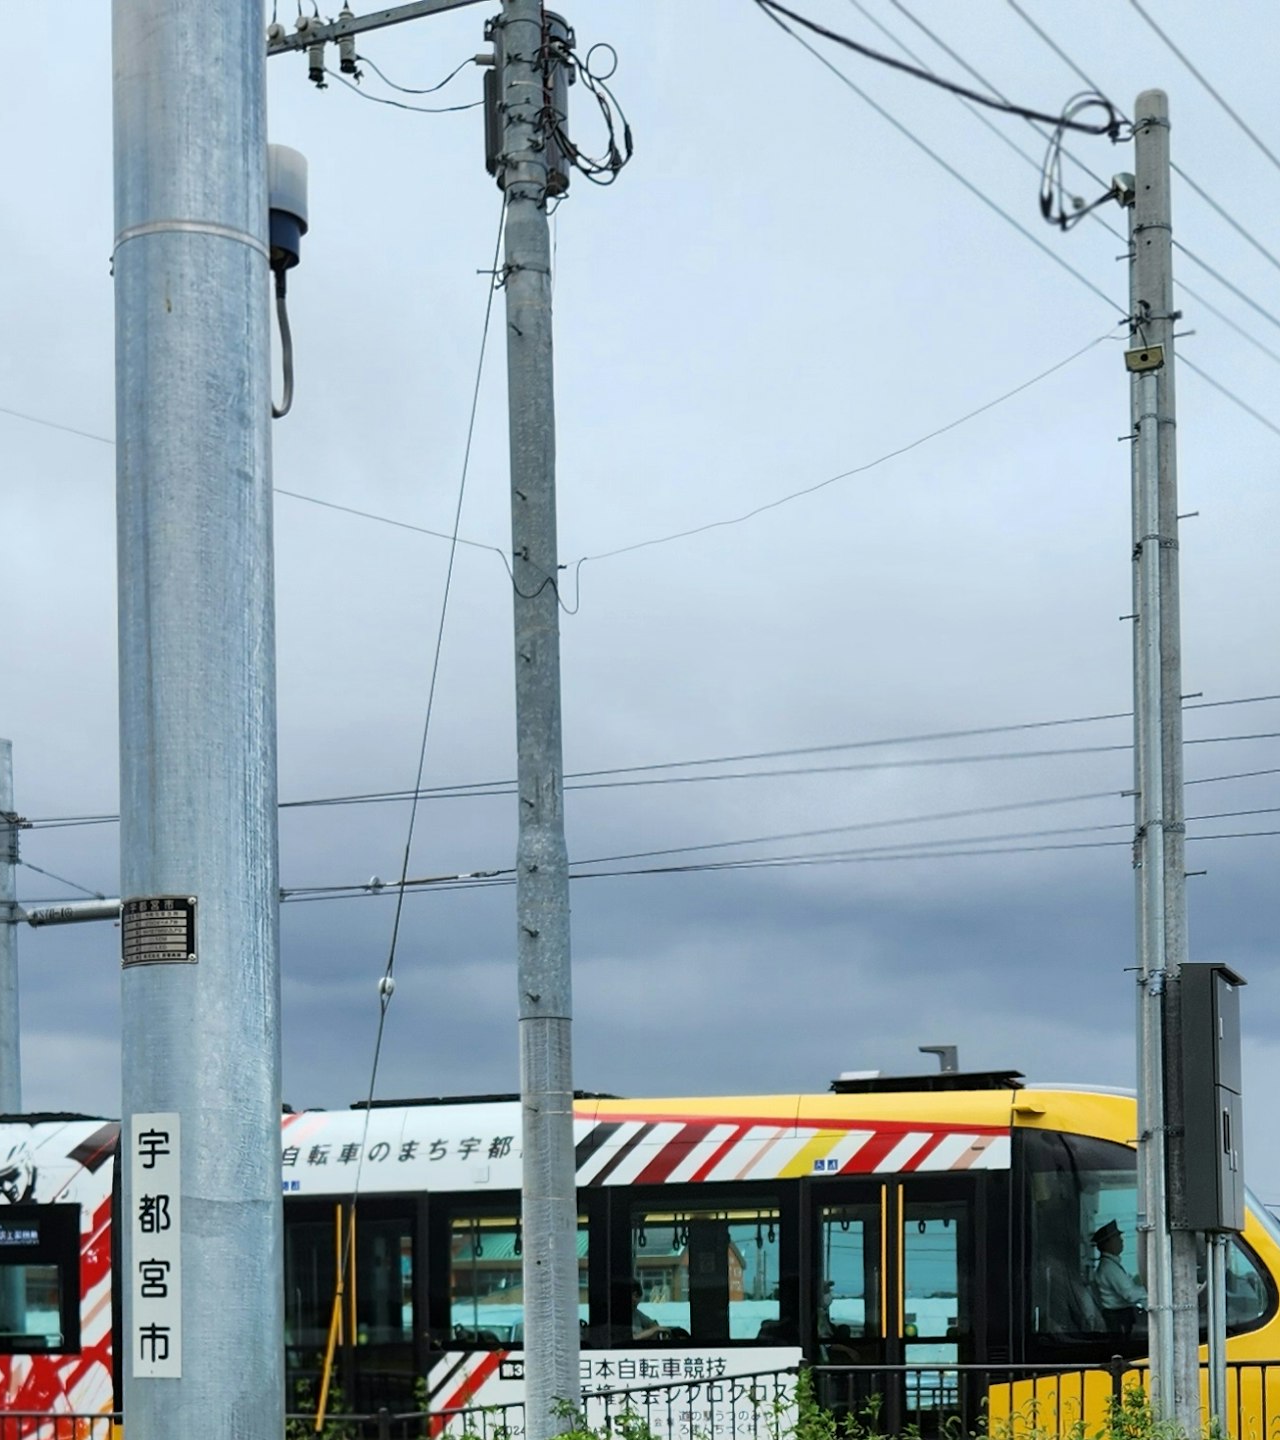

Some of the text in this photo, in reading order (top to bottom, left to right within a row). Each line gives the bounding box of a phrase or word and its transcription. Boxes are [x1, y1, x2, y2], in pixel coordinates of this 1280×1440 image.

[281, 1135, 523, 1167] 自転車のまち宇都
[138, 1127, 171, 1363] 宇都宮市
